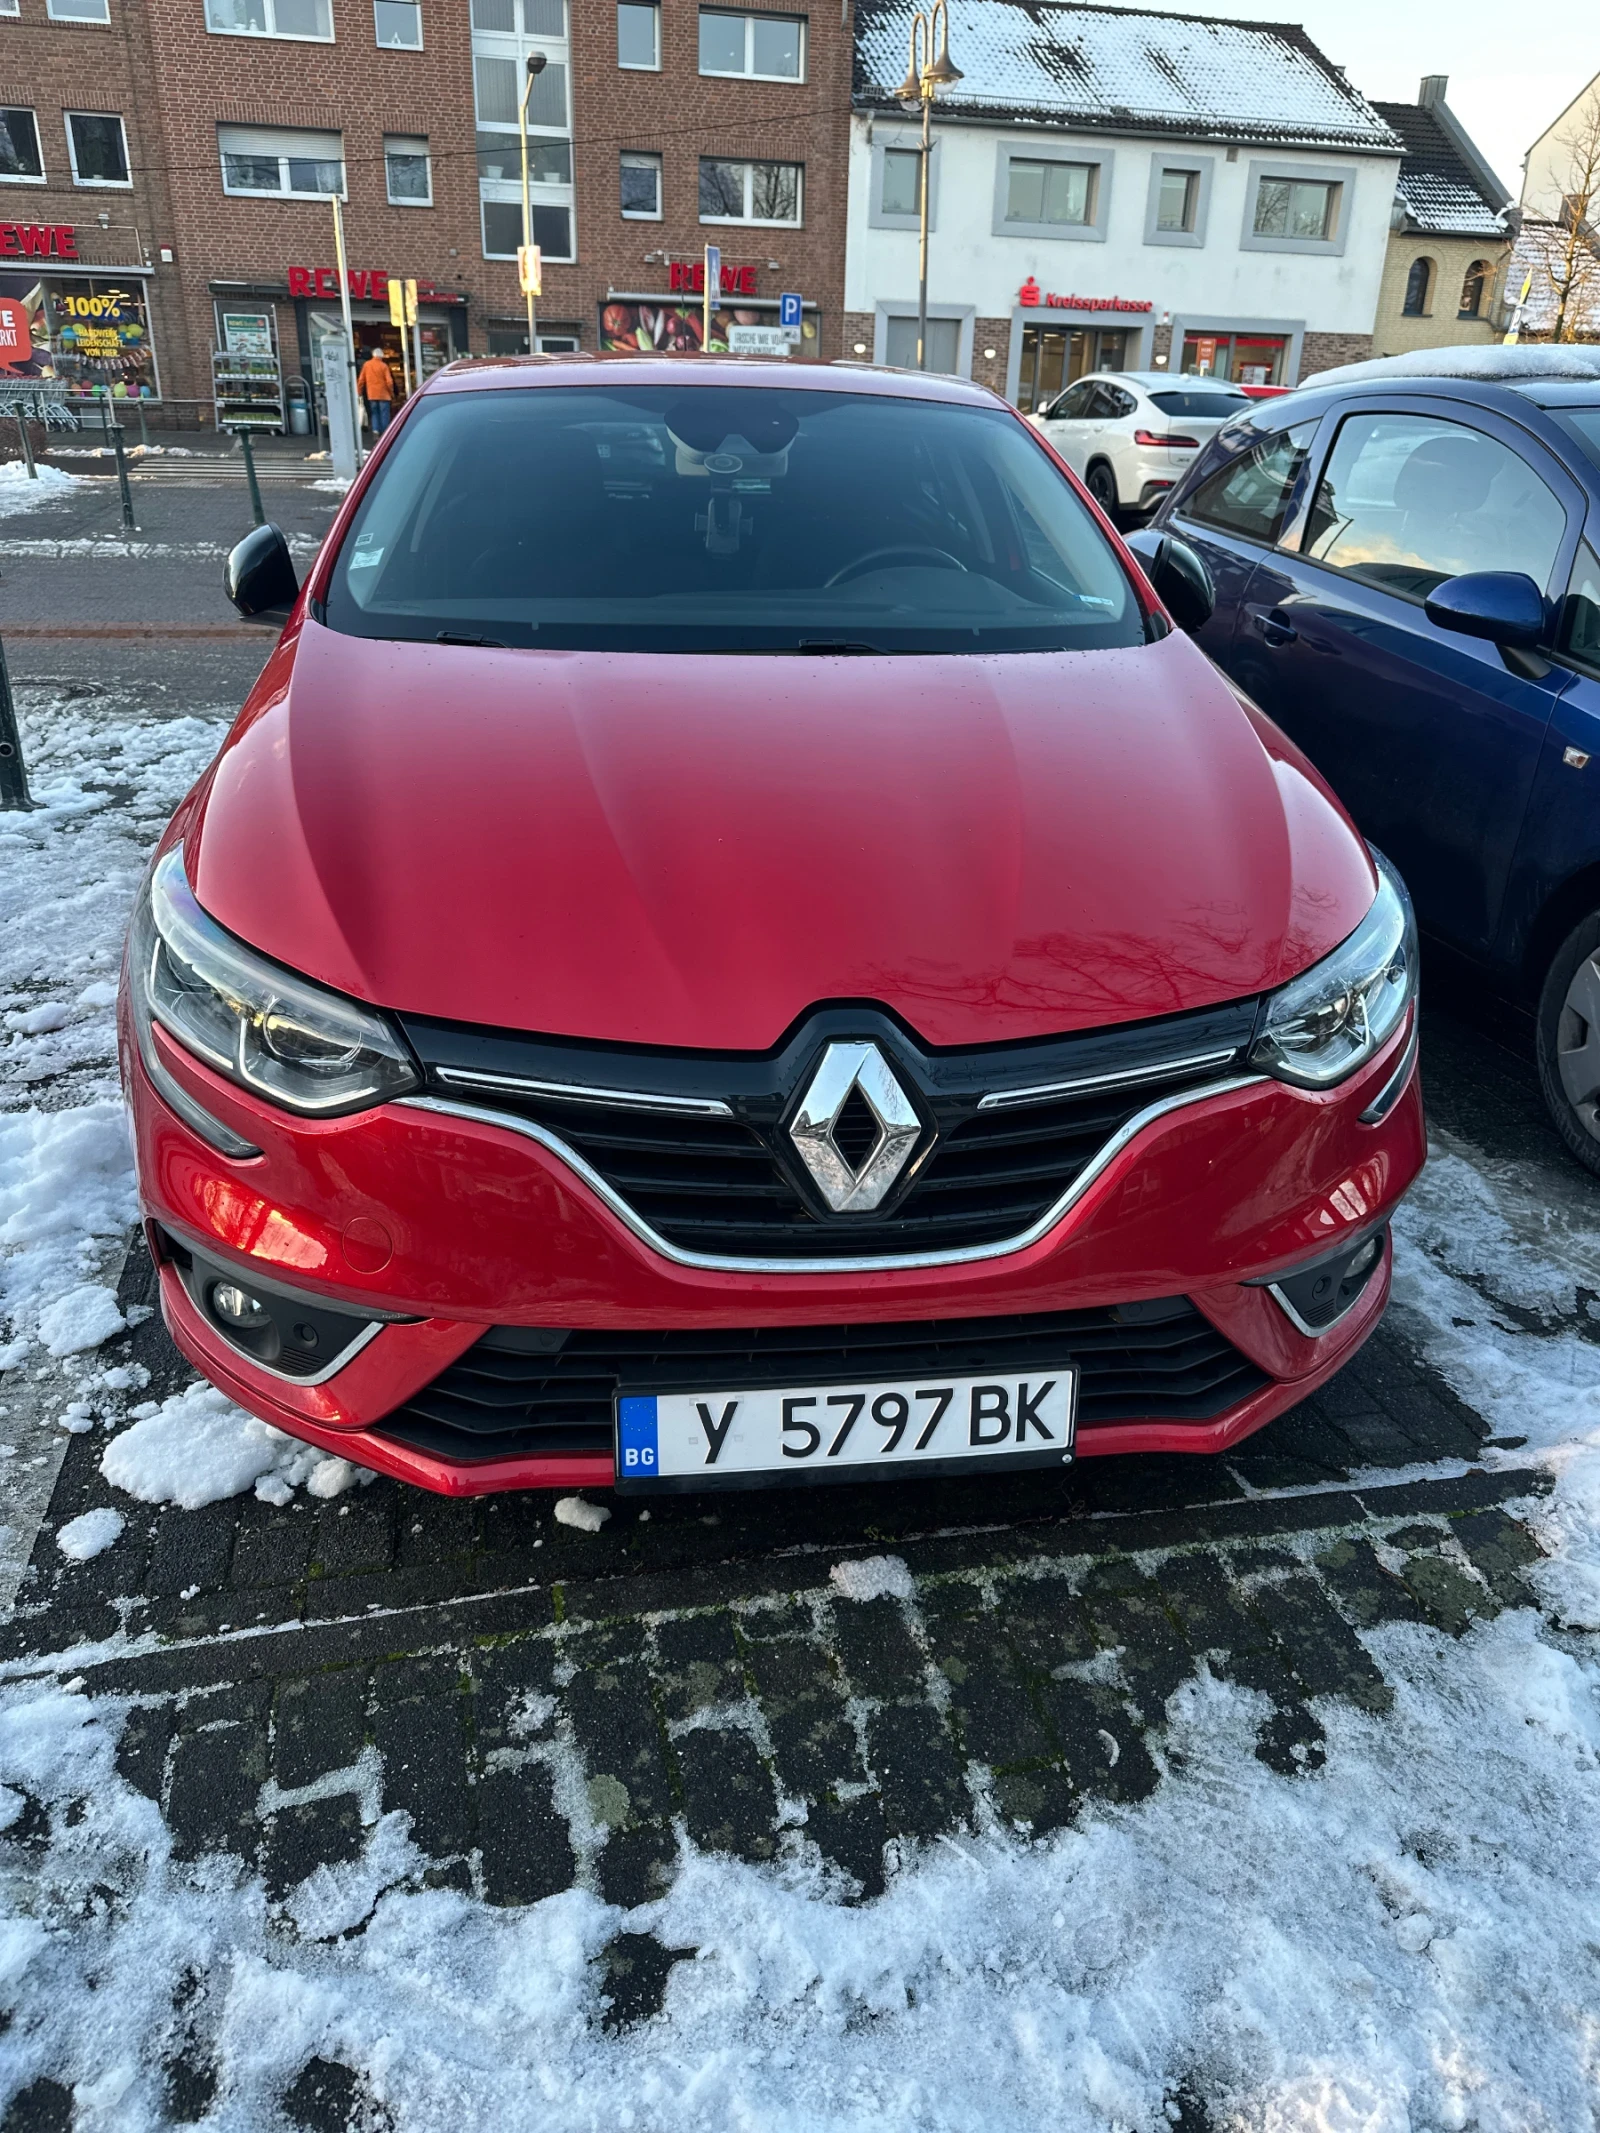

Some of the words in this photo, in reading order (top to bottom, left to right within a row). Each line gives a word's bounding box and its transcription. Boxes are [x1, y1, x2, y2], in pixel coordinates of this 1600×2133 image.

[0, 223, 79, 258] EWE
[288, 266, 389, 300] REWE
[670, 262, 757, 294] REWE
[65, 296, 120, 318] 100%
[785, 297, 798, 322] P
[1046, 293, 1153, 313] Kreissparkasse
[0, 329, 17, 347] RKT
[781, 1387, 954, 1459] 5797
[968, 1380, 1057, 1447] BK
[624, 1447, 655, 1467] BG
